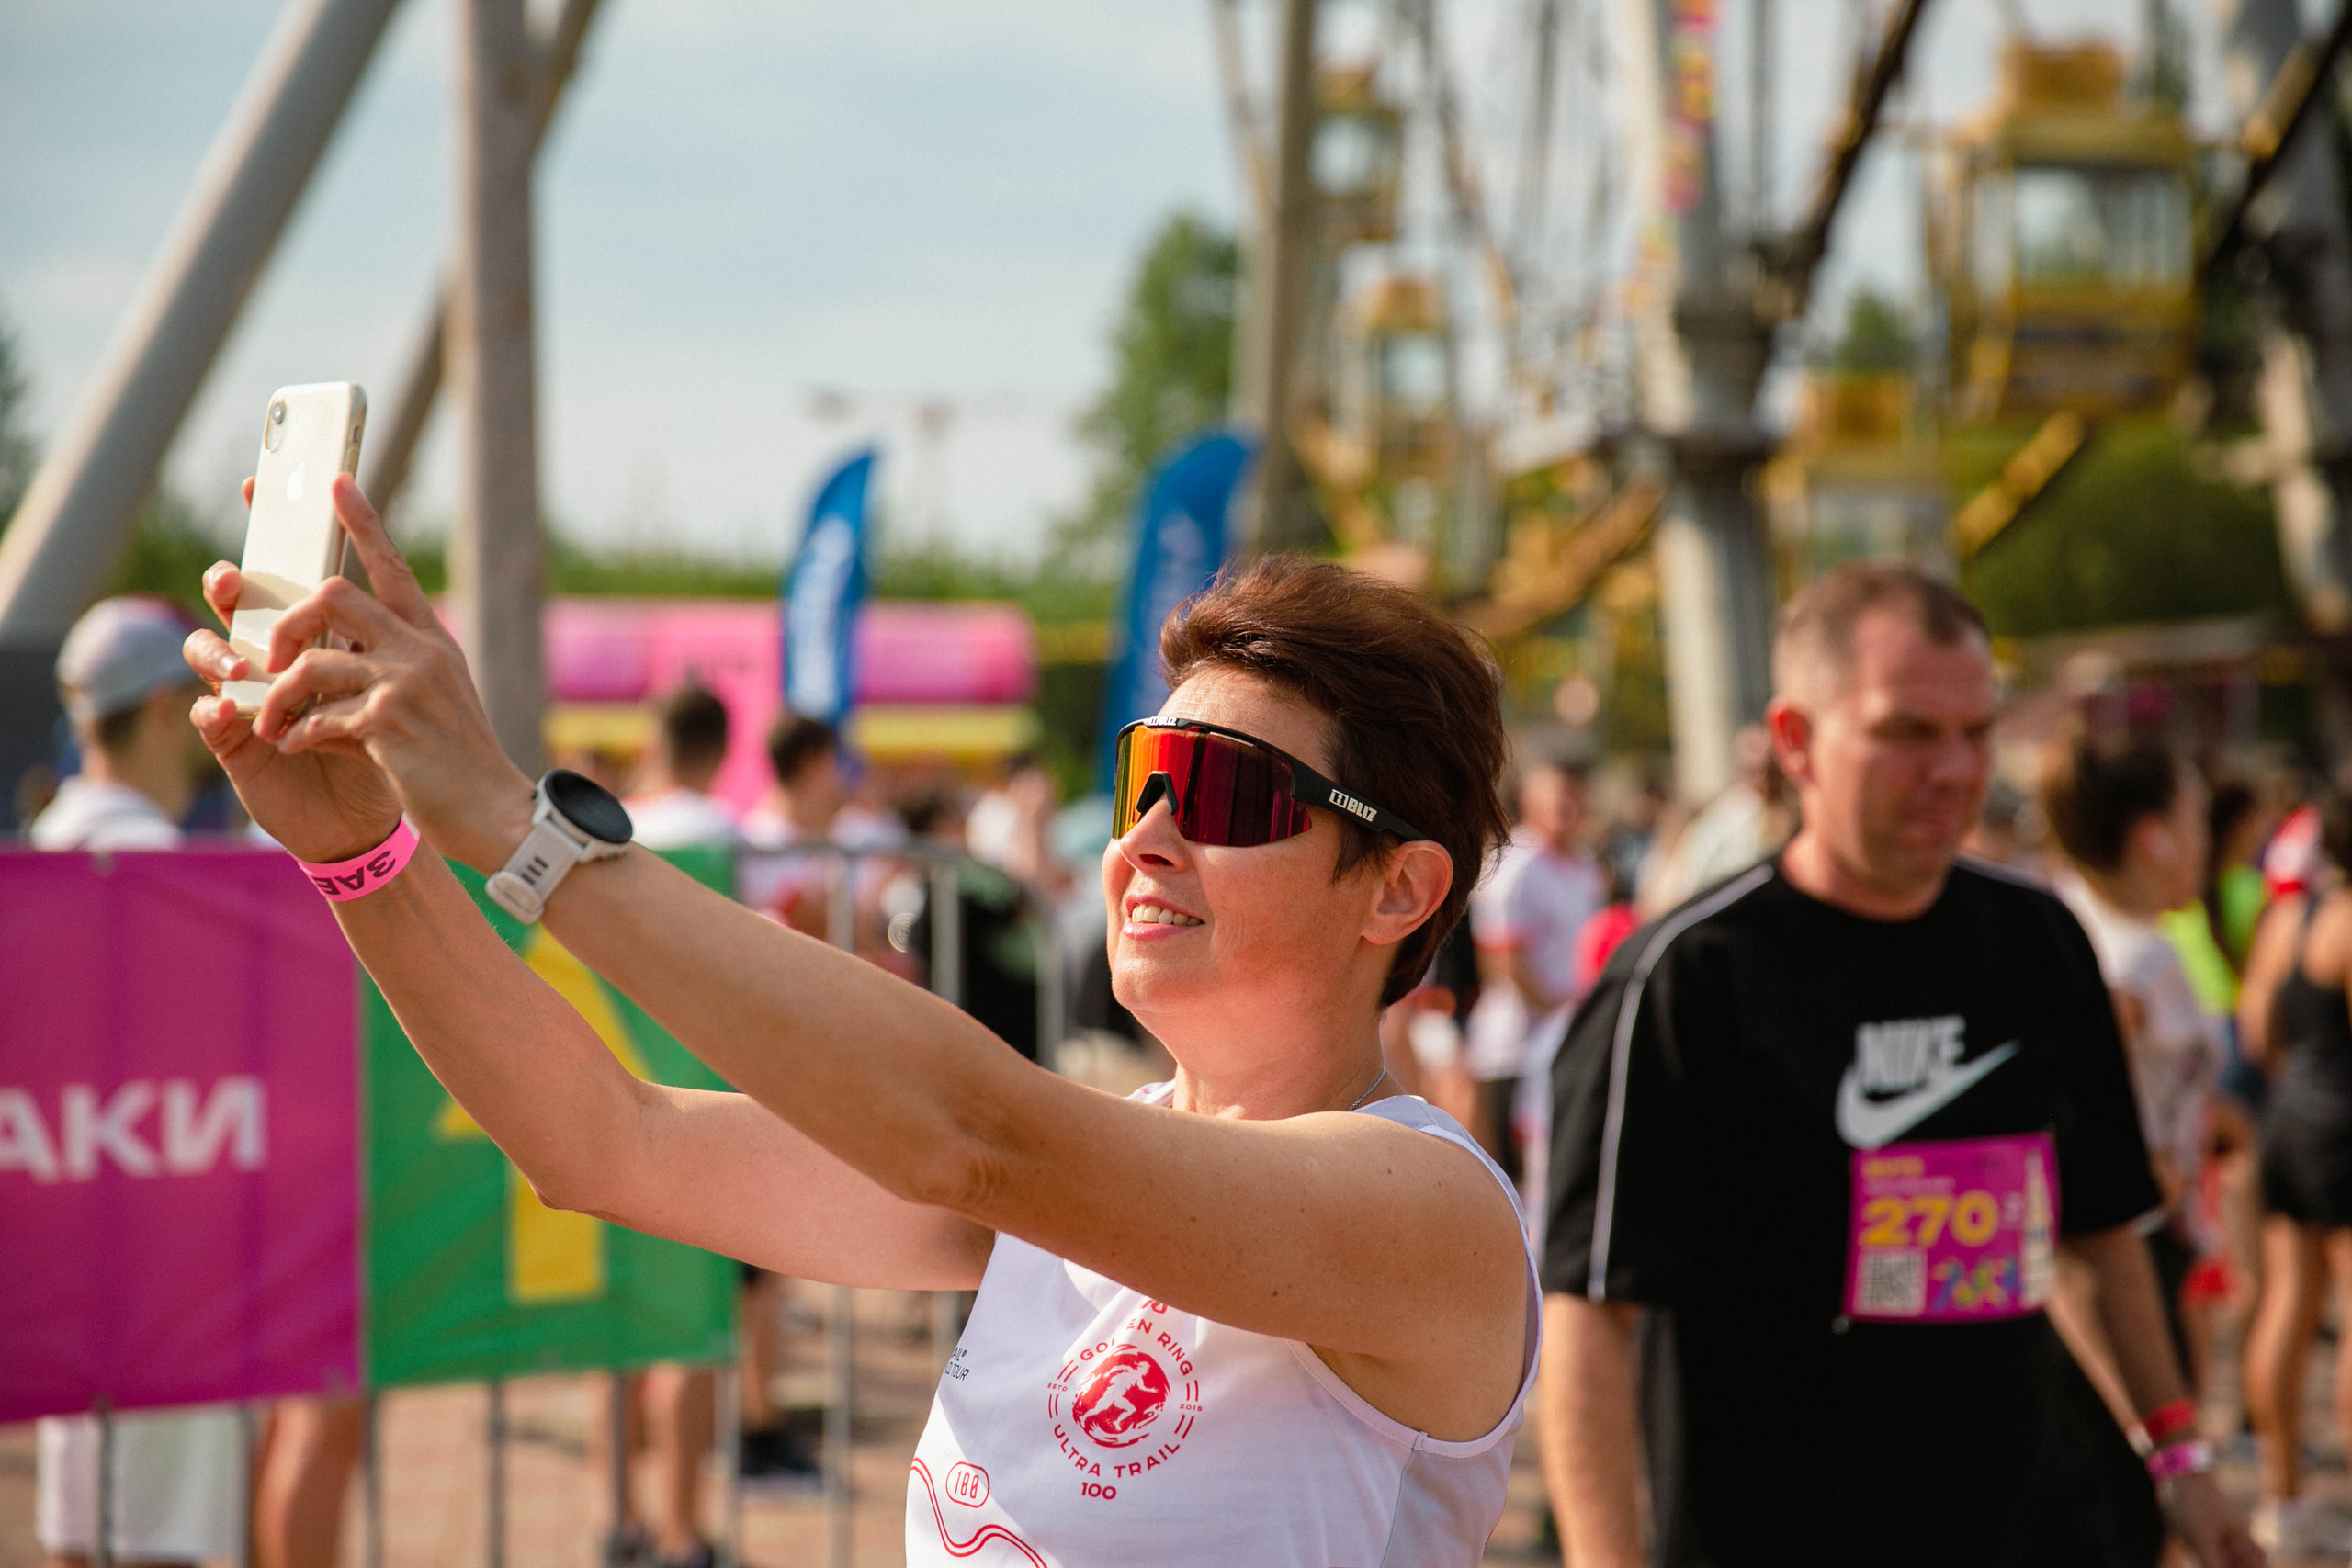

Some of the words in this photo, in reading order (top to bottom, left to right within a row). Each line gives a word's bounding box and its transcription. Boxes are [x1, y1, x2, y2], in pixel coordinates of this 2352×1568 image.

[1347, 796, 1378, 822] BLIZ
[1854, 1012, 1966, 1093] NIKE
[1858, 1190, 2000, 1249] 270
[1080, 1318, 1152, 1361] GOEN
[1157, 1331, 1193, 1376] RING
[1046, 1382, 1069, 1393] ESTD
[1054, 1424, 1101, 1476] ULTRA
[1114, 1443, 1181, 1478] TRAIL
[1080, 1481, 1117, 1500] 100
